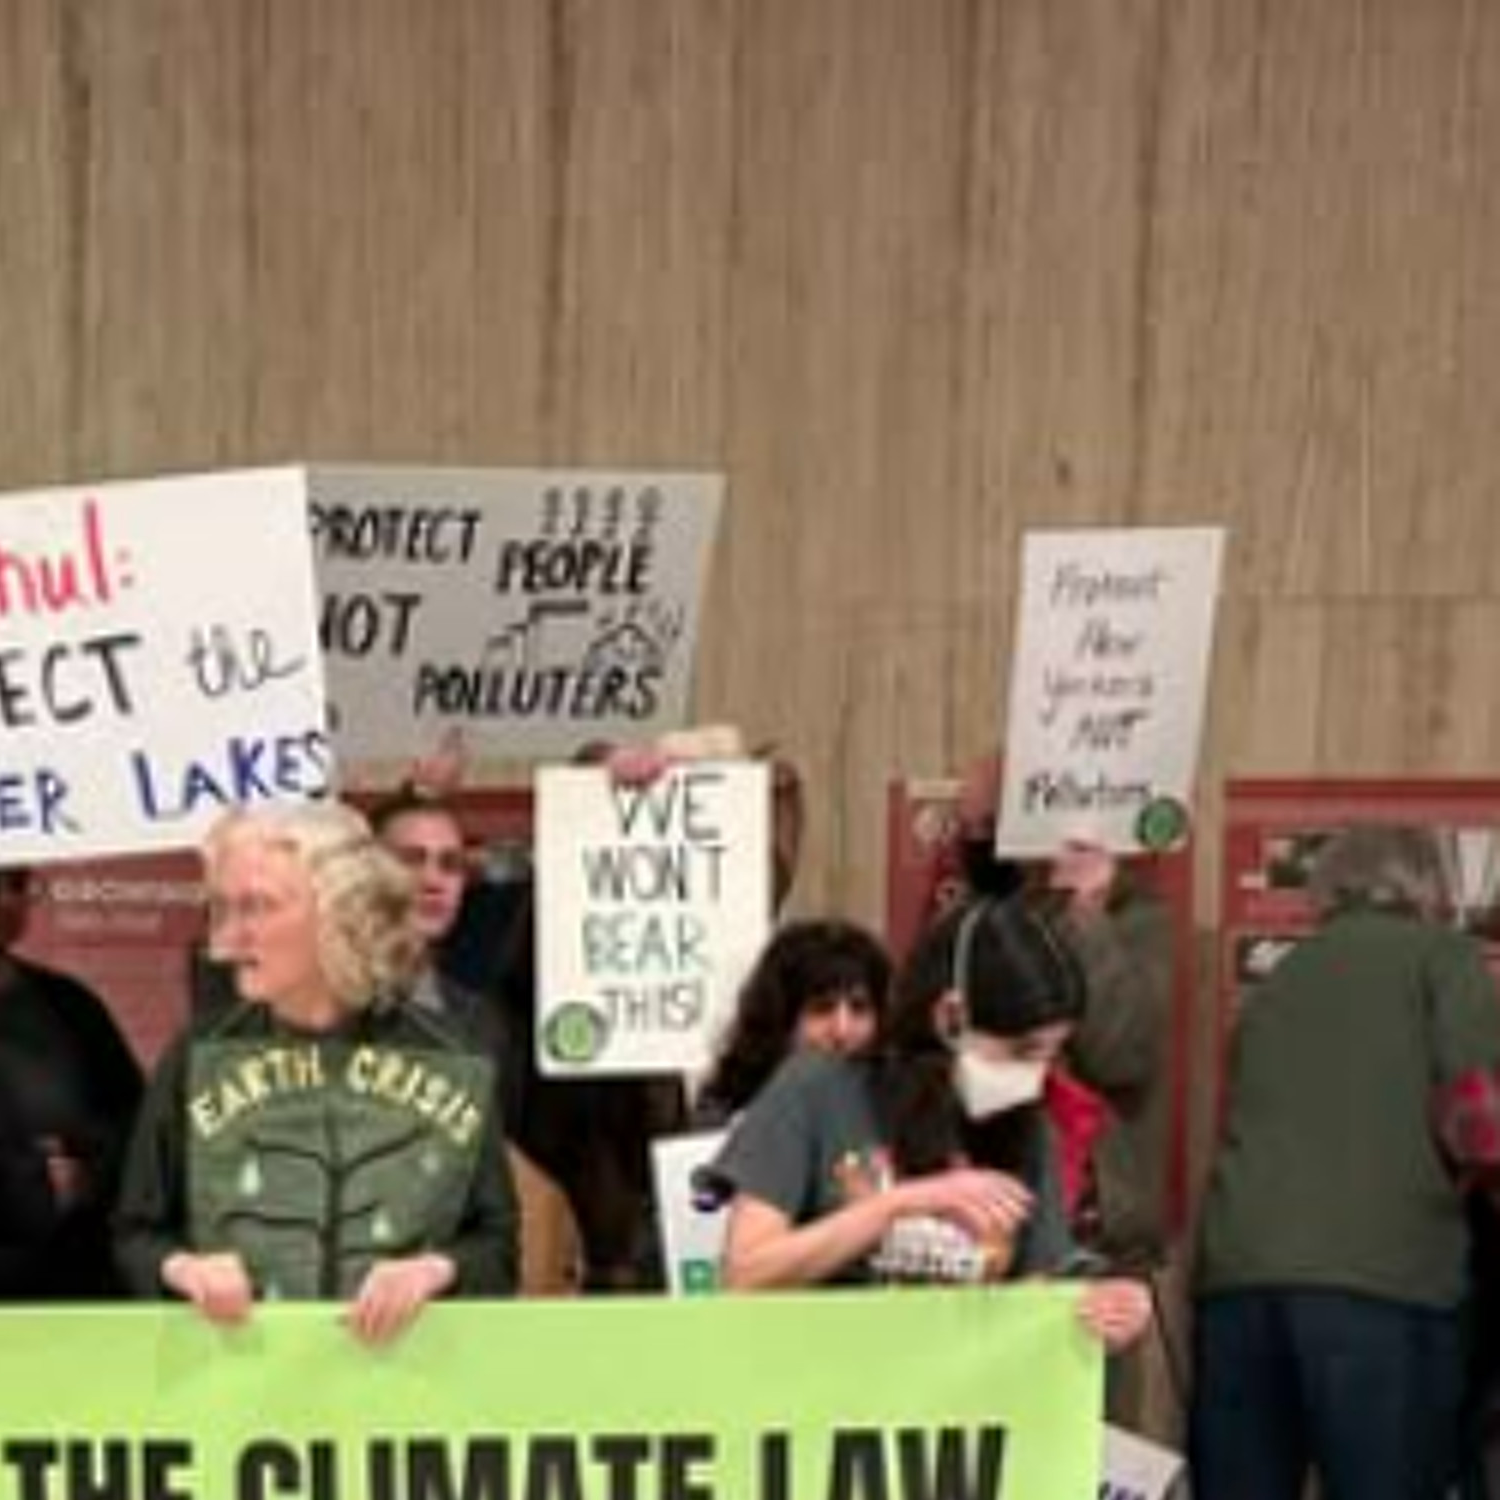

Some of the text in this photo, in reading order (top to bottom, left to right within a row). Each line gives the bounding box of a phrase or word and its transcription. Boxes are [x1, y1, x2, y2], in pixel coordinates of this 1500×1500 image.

[496, 540, 656, 595] PEOPLE
[188, 625, 306, 698] the
[414, 665, 667, 721] POLLUTERS
[132, 729, 329, 820] LAKES
[581, 912, 714, 975] BEAR
[188, 1044, 482, 1143] EARTH CRISIS
